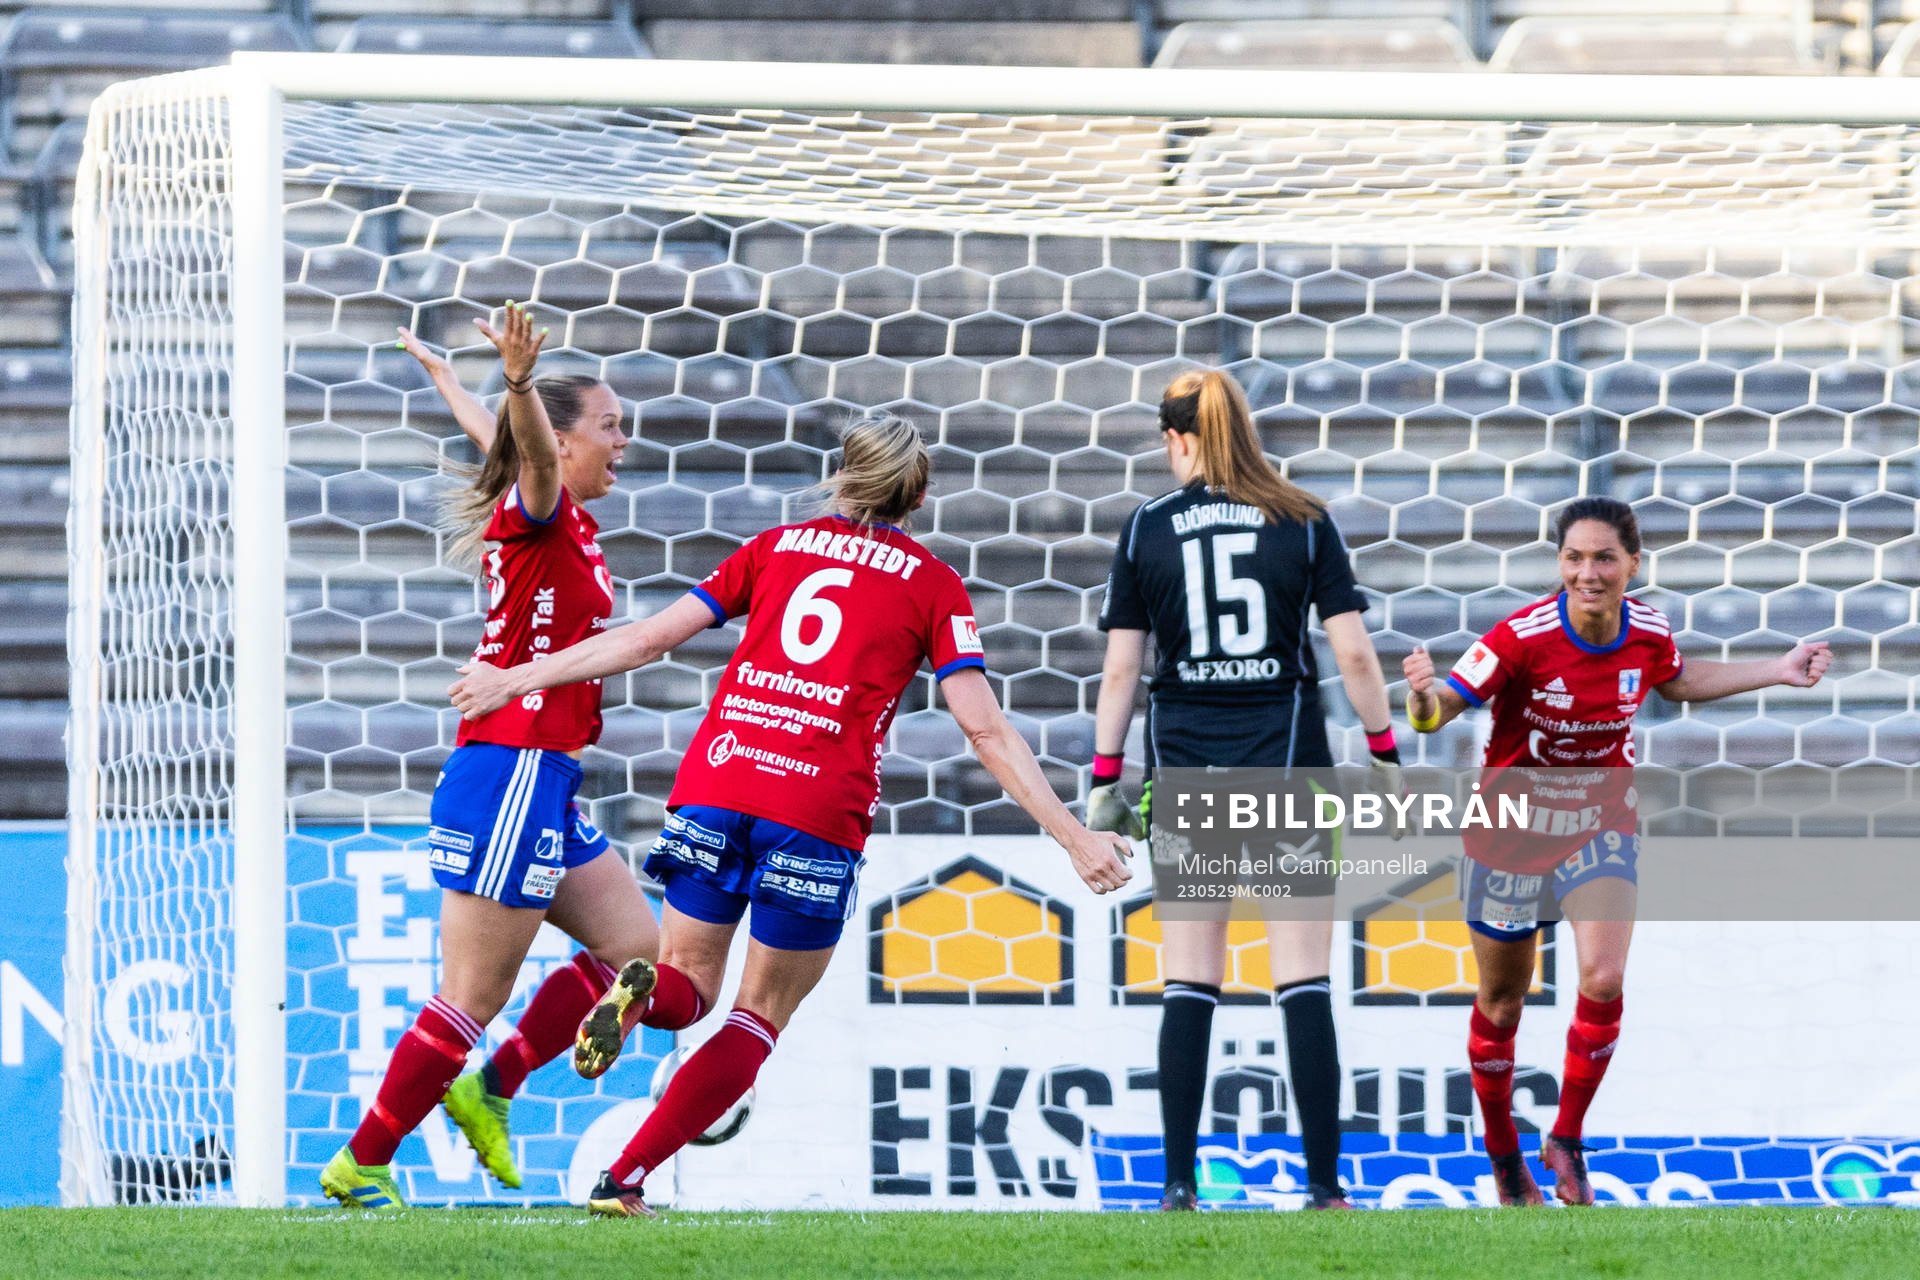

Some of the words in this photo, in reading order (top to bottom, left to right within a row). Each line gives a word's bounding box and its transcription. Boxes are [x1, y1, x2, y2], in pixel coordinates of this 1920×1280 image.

[1171, 503, 1266, 535] BJÖRKLUND
[773, 528, 922, 580] MARKSTEDT
[531, 587, 555, 629] Tak
[1181, 532, 1267, 658] 15
[780, 567, 854, 665] 6
[737, 661, 846, 706] furninova
[723, 693, 842, 734] Motorcentrum
[780, 722, 803, 735] AB
[733, 743, 821, 778] MUSIKHUSET
[770, 872, 836, 897] PEAB
